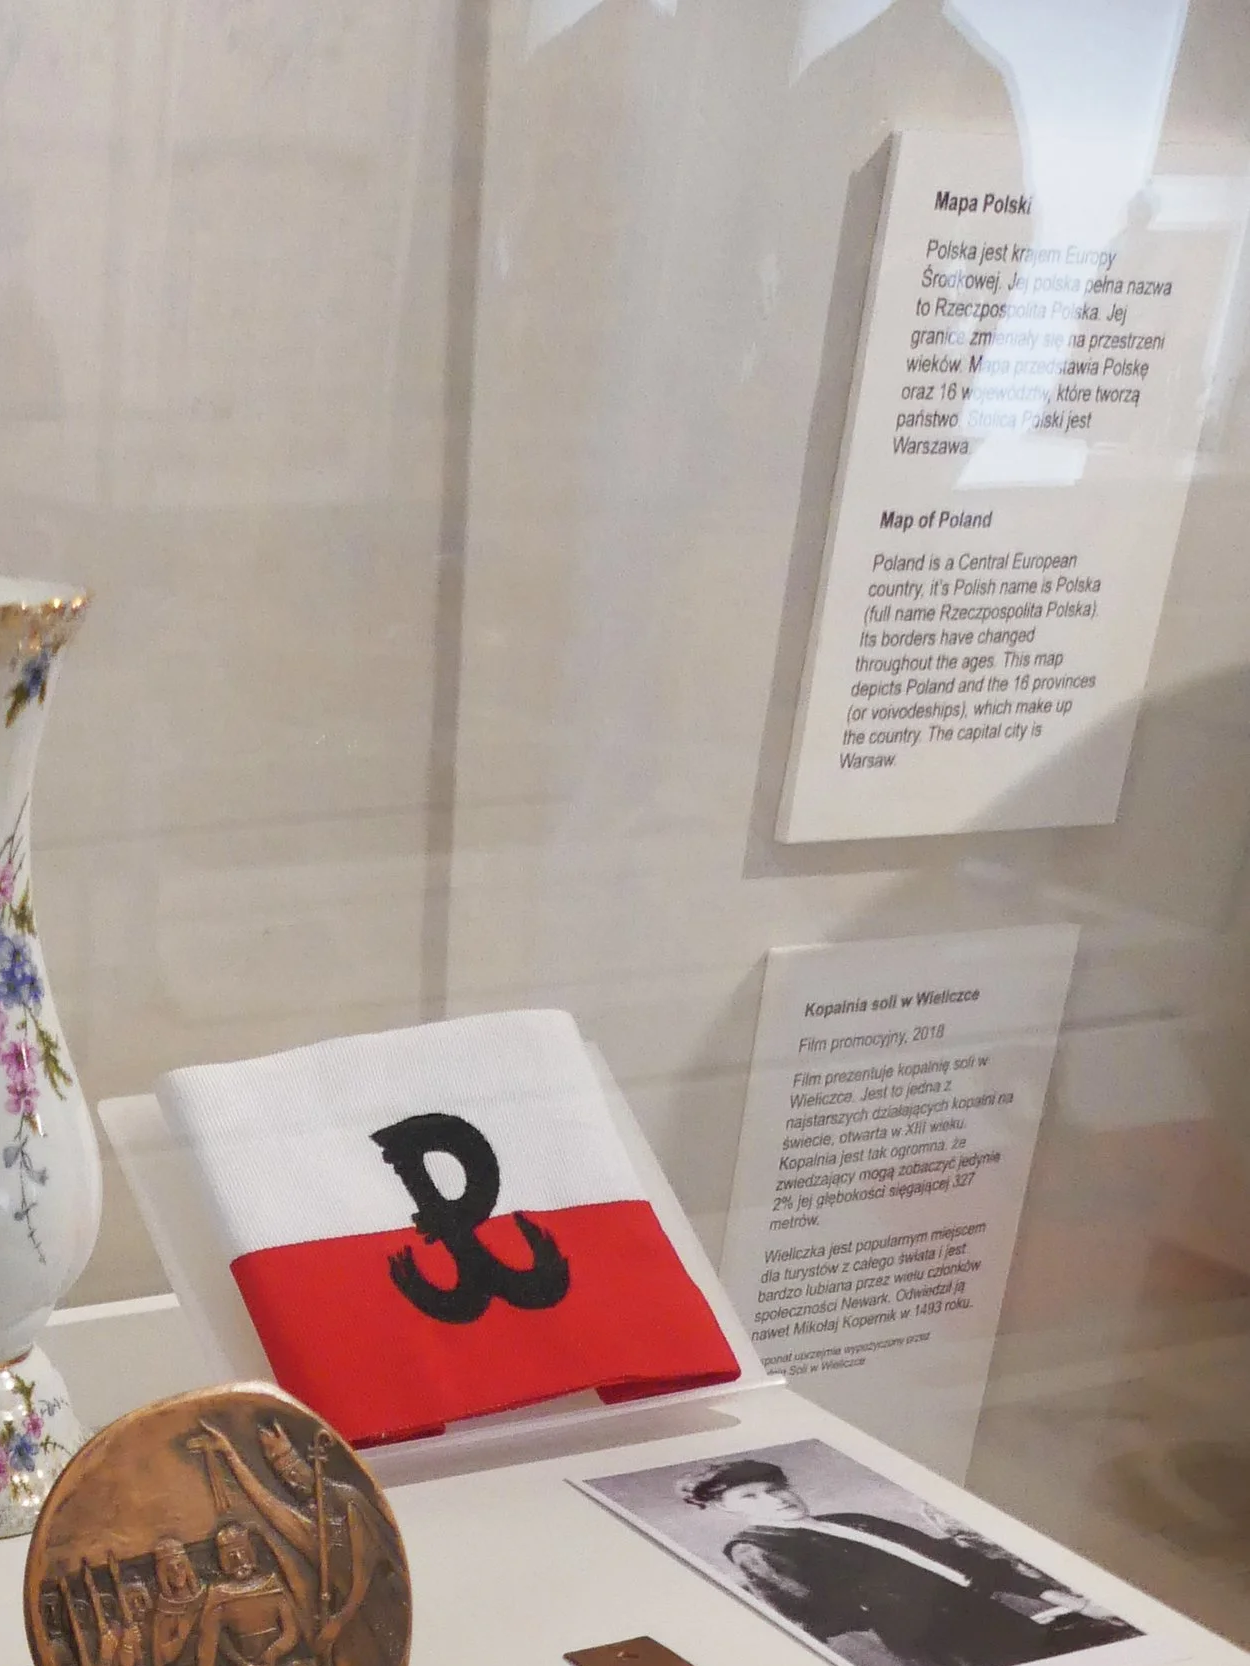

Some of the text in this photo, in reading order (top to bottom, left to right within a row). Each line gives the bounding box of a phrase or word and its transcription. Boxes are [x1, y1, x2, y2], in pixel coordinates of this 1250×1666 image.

[935, 191, 1032, 216] Mapa Polski
[926, 240, 1117, 269] Polska jest krajem Europy
[921, 266, 1172, 297] Środkowej. Jej polska pełna nazwa
[916, 299, 1128, 326] to Rzeczpospolita Jej
[910, 329, 1165, 353] granice się na przestrzeni
[906, 355, 1148, 380] wieków. Mapa przedstawia Polskę
[901, 383, 1140, 406] oraz 16 które tworzą
[1022, 411, 1092, 432] Polski jest
[880, 510, 993, 532] Map of Poland
[872, 553, 1077, 572] Poland is a Central European
[868, 577, 1101, 600] country, it's Polish name is Polska
[864, 601, 1098, 624] (full name Rzeczpospolita Polska).
[859, 628, 1035, 648] Its borders have changed
[855, 652, 1063, 674] throughout the ages. This map
[851, 674, 1095, 698] depicts Poland and the 16 provinces
[847, 699, 1072, 721] (or voivodeships), which make up
[843, 723, 1042, 747] the country. The capital city is
[840, 753, 896, 769] Warsaw.
[805, 988, 980, 1018] Kopalnia soli w Wieliczce
[798, 1024, 945, 1053] Film promocyjny, 2018
[792, 1057, 988, 1088] Film prezentuje kopalnię soli w
[860, 1080, 952, 1102] Jest to jedna z
[785, 1092, 1013, 1130] najstarszych kopalni na
[783, 1127, 901, 1151] świecie, otwarta w
[779, 1137, 966, 1171] Kopalnia jest tak że
[776, 1151, 1001, 1192] zwiedzający mogą zobaczyć jedynie
[772, 1172, 975, 1211] 2% jej głębokości 327
[769, 1215, 819, 1231] metrów.
[764, 1223, 986, 1264] Wieliczka jest popularnym miejscem
[760, 1243, 967, 1284] dla turystów z całego świata i jest
[758, 1261, 981, 1303] bardzo lubiana przez wielu członków
[754, 1280, 965, 1323] społeczności Newark. Odwiedził ją
[752, 1298, 973, 1342] nawet Mikołaj Kopernik w 1493 roku.
